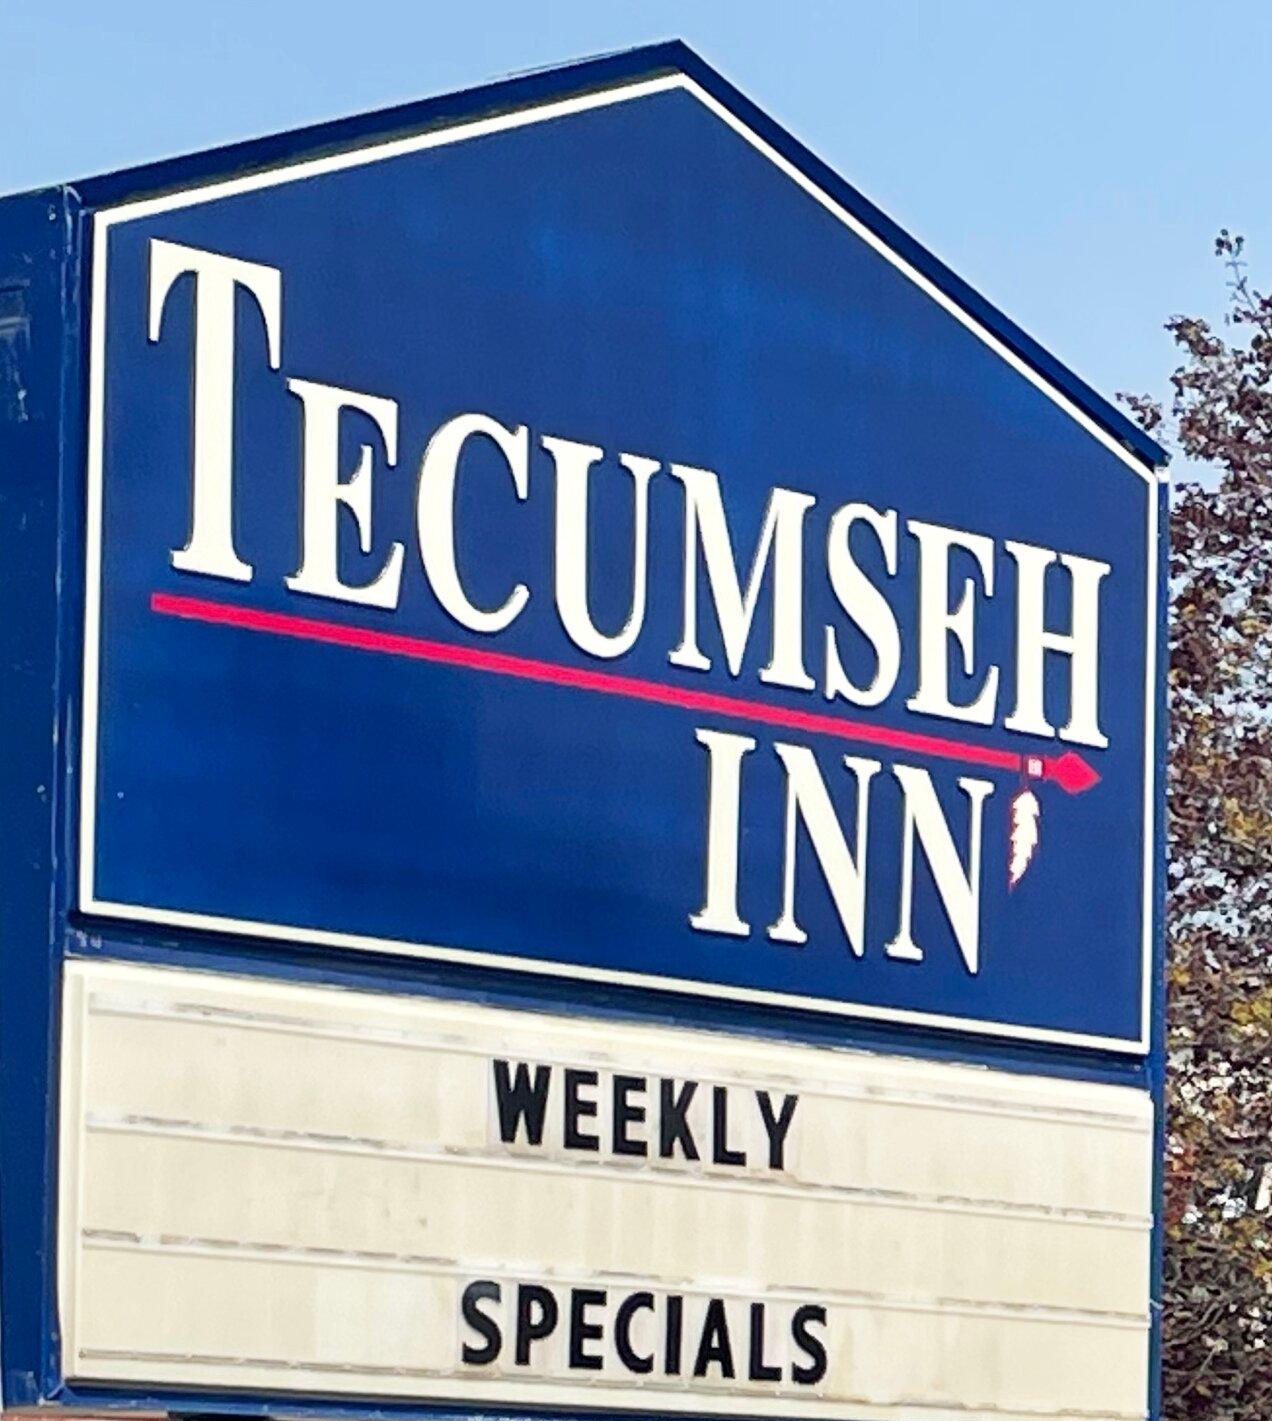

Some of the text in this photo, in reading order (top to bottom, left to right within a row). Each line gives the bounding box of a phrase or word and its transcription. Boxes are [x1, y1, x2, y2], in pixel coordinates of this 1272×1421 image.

[149, 238, 1111, 747] TECUMSEH
[688, 727, 994, 976] INN
[493, 1059, 799, 1170] WEEKLY
[461, 1280, 828, 1385] SPECIALS
